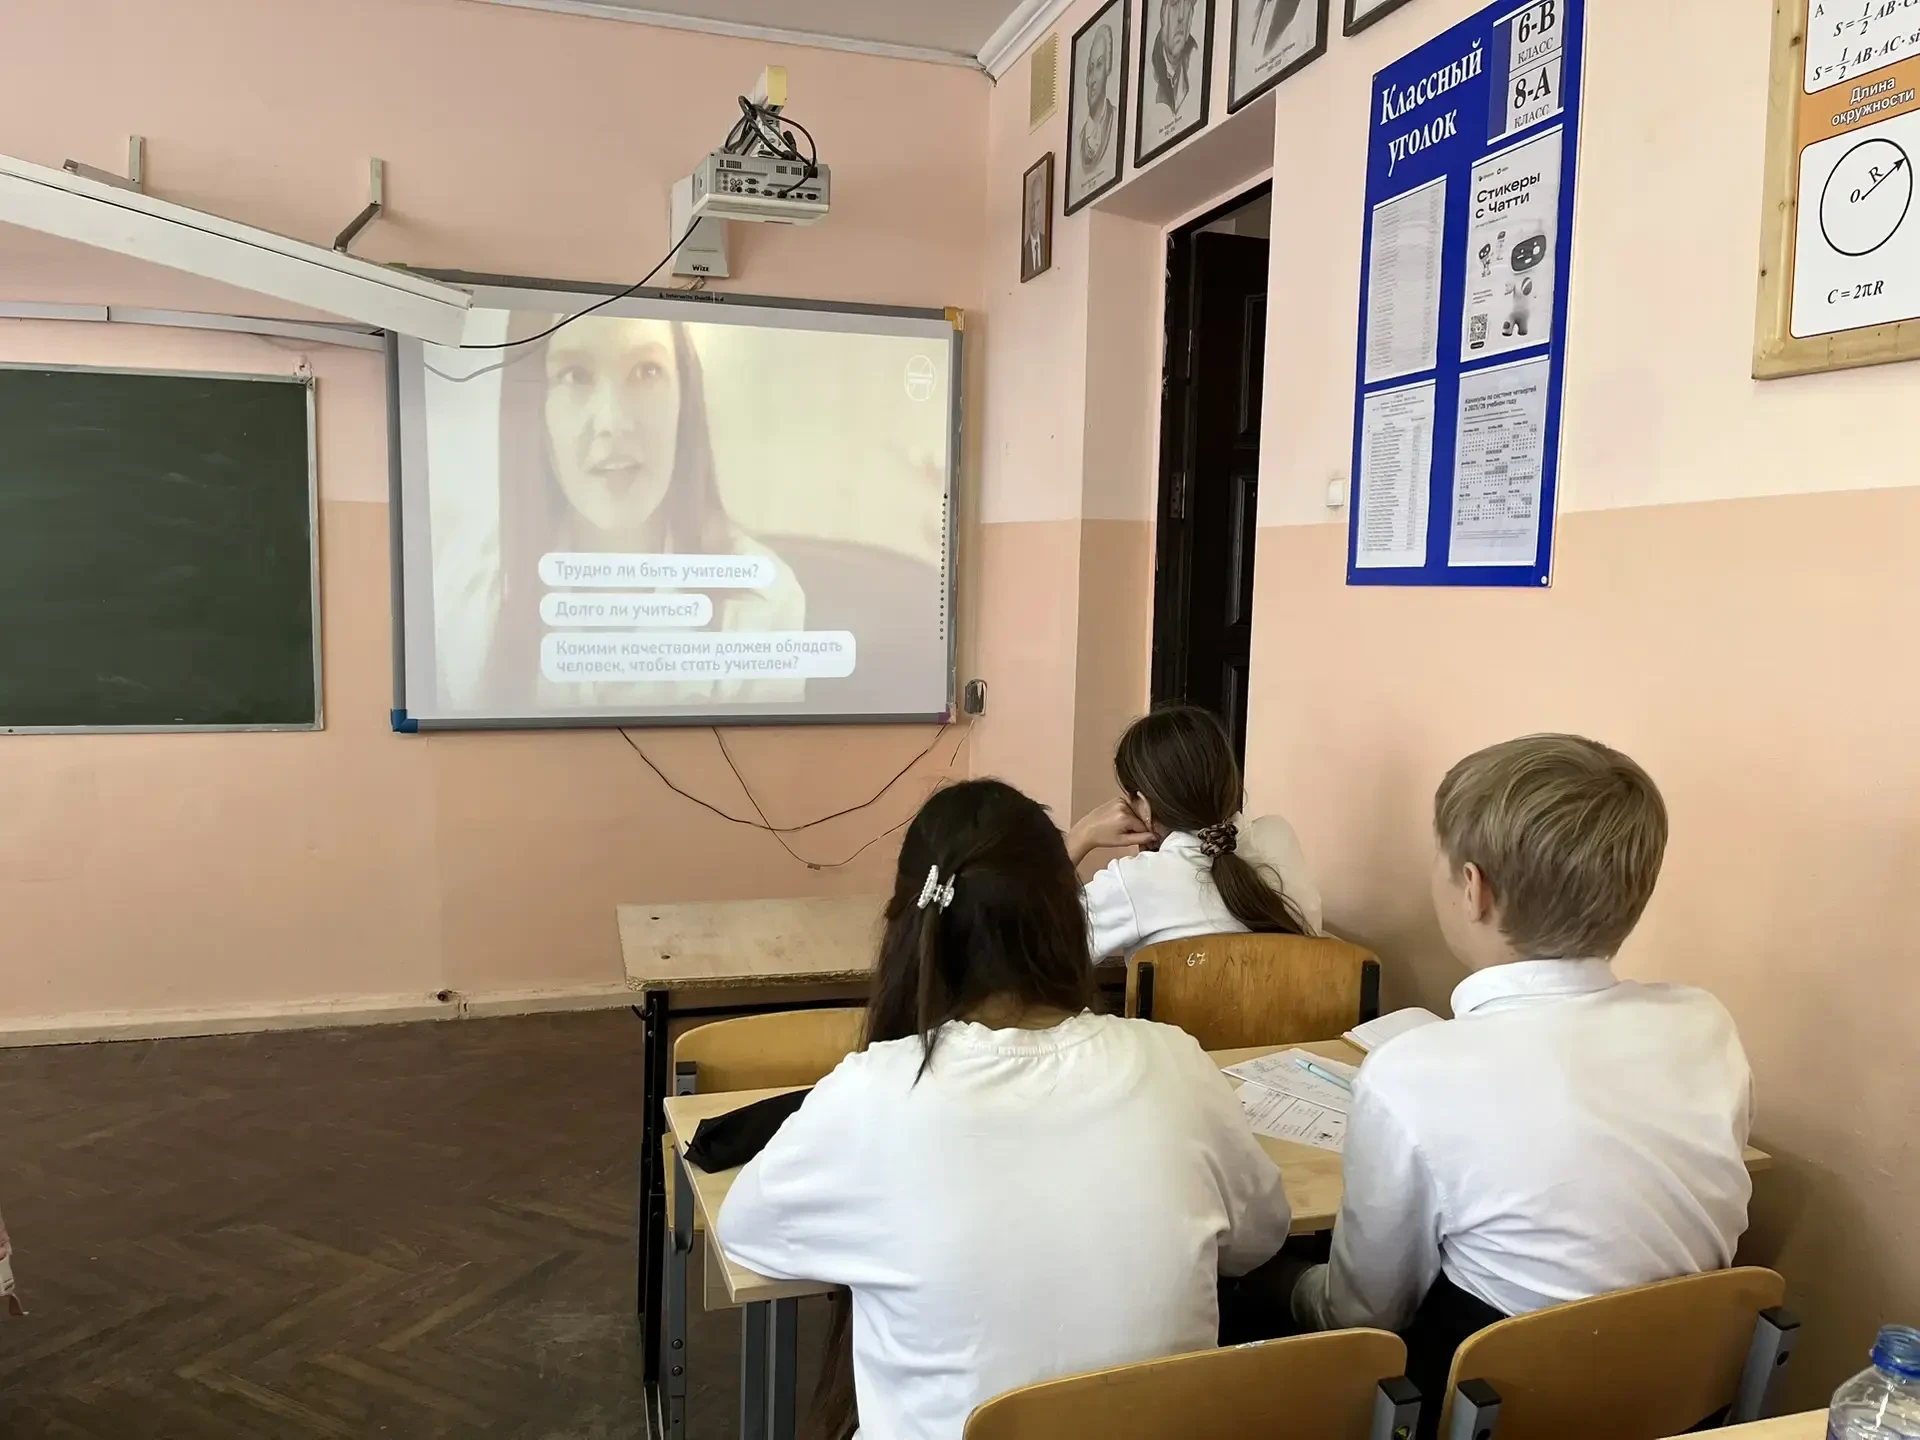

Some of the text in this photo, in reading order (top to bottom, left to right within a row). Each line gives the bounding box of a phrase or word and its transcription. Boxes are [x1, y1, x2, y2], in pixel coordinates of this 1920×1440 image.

[1516, 37, 1554, 64] КЛАСС
[1379, 37, 1484, 126] Классный
[1514, 66, 1552, 110] 8-А
[1849, 77, 1896, 105] Длина
[1513, 104, 1550, 129] КЛАСС
[1831, 88, 1916, 126] окружности
[1387, 109, 1458, 178] уголок
[1476, 172, 1541, 204] Стикеры
[1868, 165, 1885, 186] R
[1475, 192, 1530, 219] с Чатти
[554, 560, 760, 583] Трудно ли быть учителем?
[554, 601, 700, 620] Долго ли учиться?
[555, 638, 843, 656] Какими качествами должен обладать
[556, 655, 800, 674] человек, чтобы стать учителем?
[1186, 951, 1206, 967] 67
